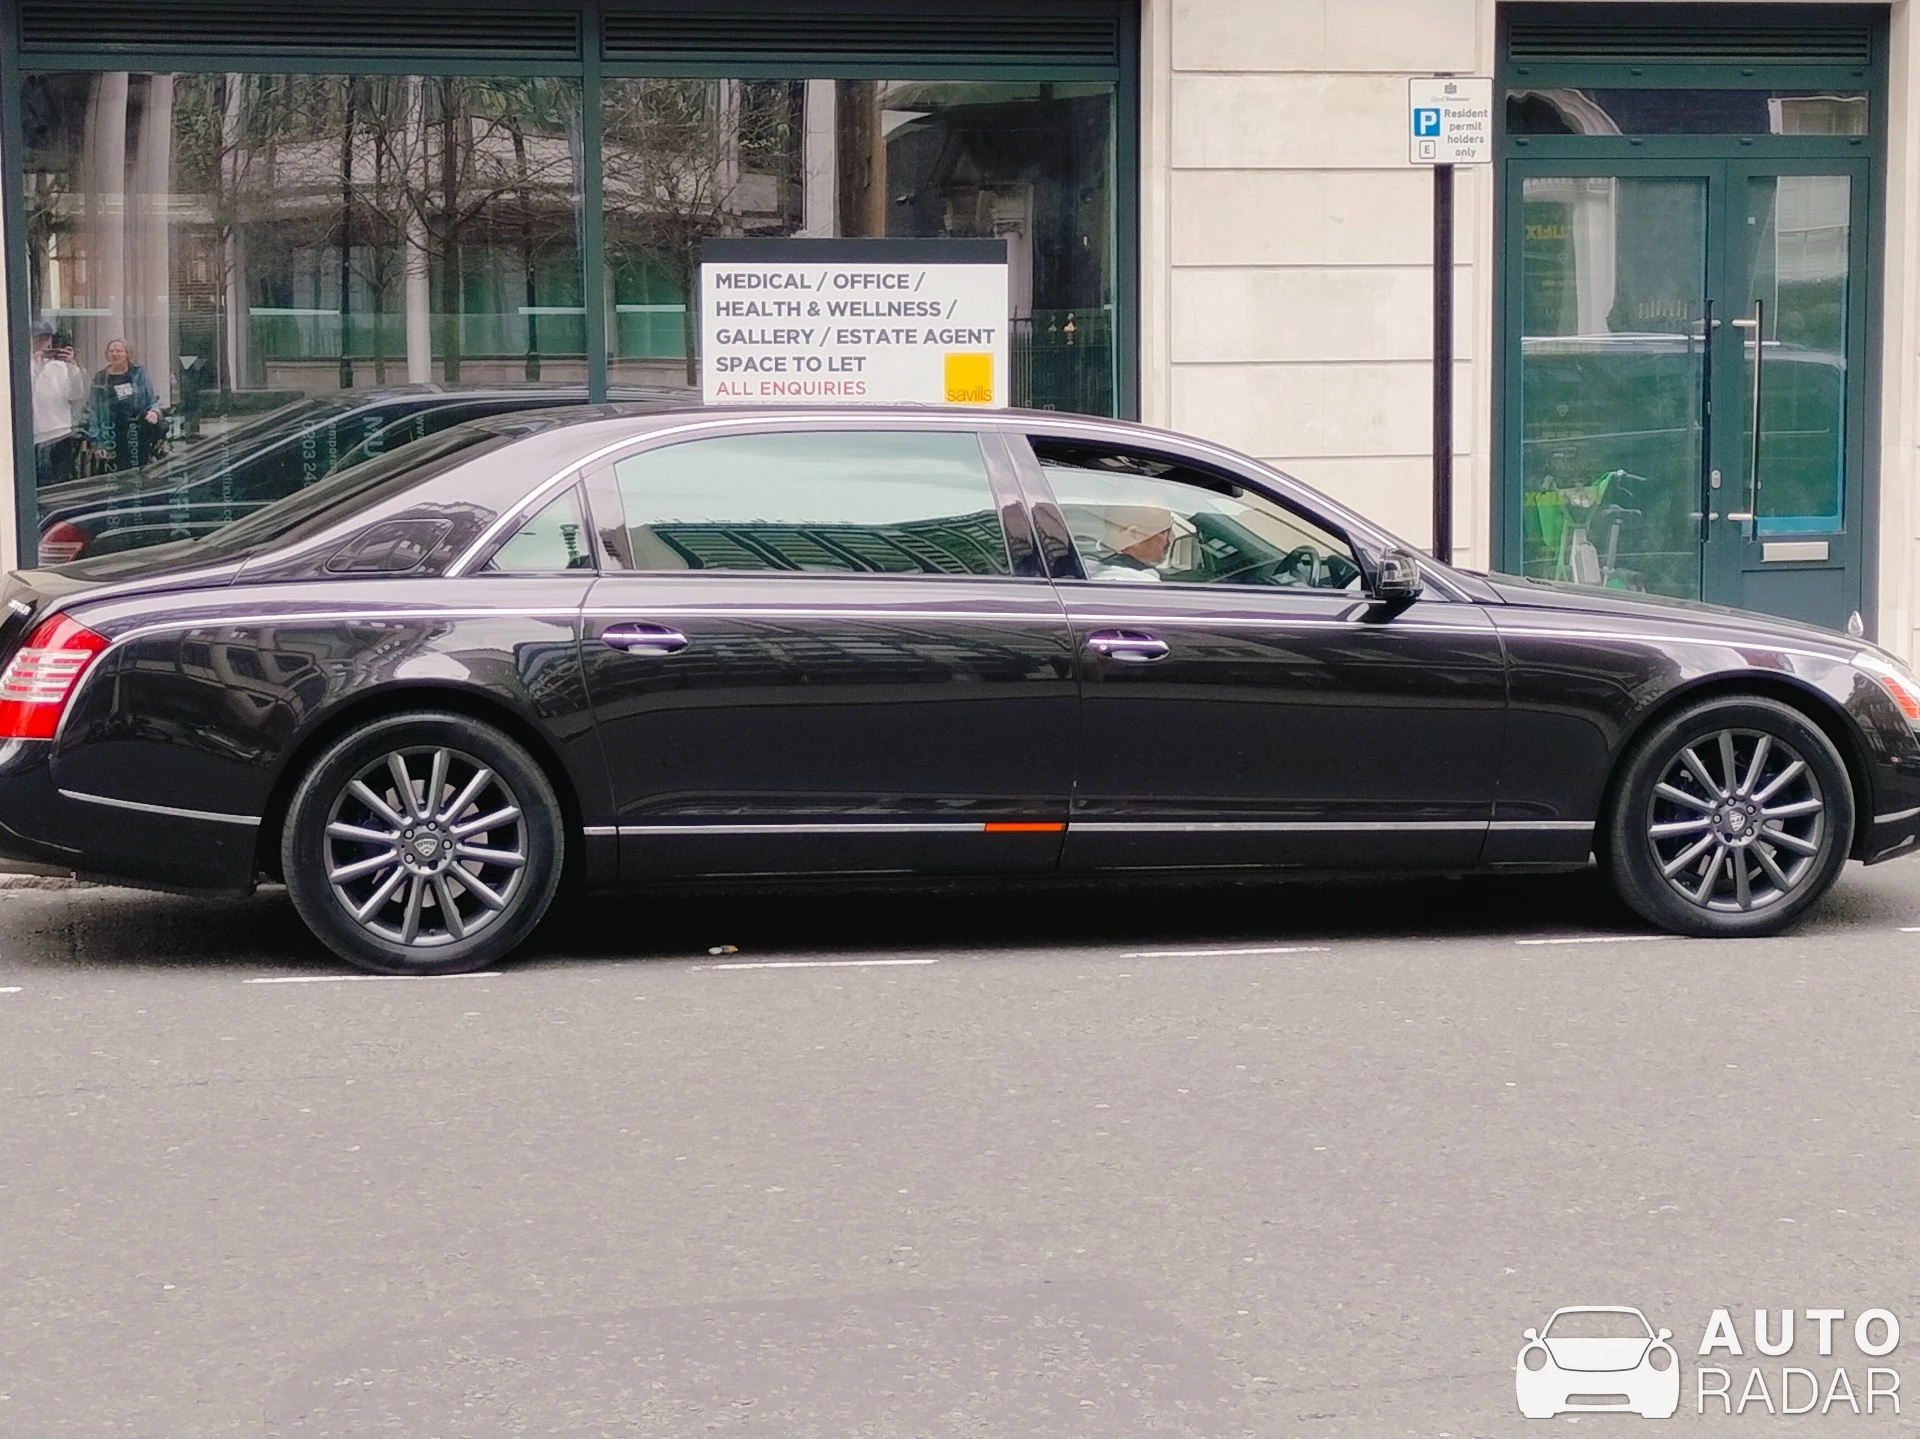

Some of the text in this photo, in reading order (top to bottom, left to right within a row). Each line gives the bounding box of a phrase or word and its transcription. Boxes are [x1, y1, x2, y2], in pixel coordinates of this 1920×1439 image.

[1444, 108, 1488, 118] Resident
[1420, 111, 1437, 135] P
[1449, 121, 1482, 133] permit
[1447, 134, 1485, 144] holders
[1424, 144, 1431, 155] E
[1454, 147, 1477, 158] only
[715, 271, 926, 292] MEDICAL / OFFICE /
[716, 299, 958, 320] HEALTH & WELLNESS /
[716, 326, 996, 348] GALLERY / ESTATE AGENT
[716, 356, 867, 373] SPACE TO LET
[716, 381, 866, 397] ALL ENQUIRIES
[946, 385, 993, 402] savills
